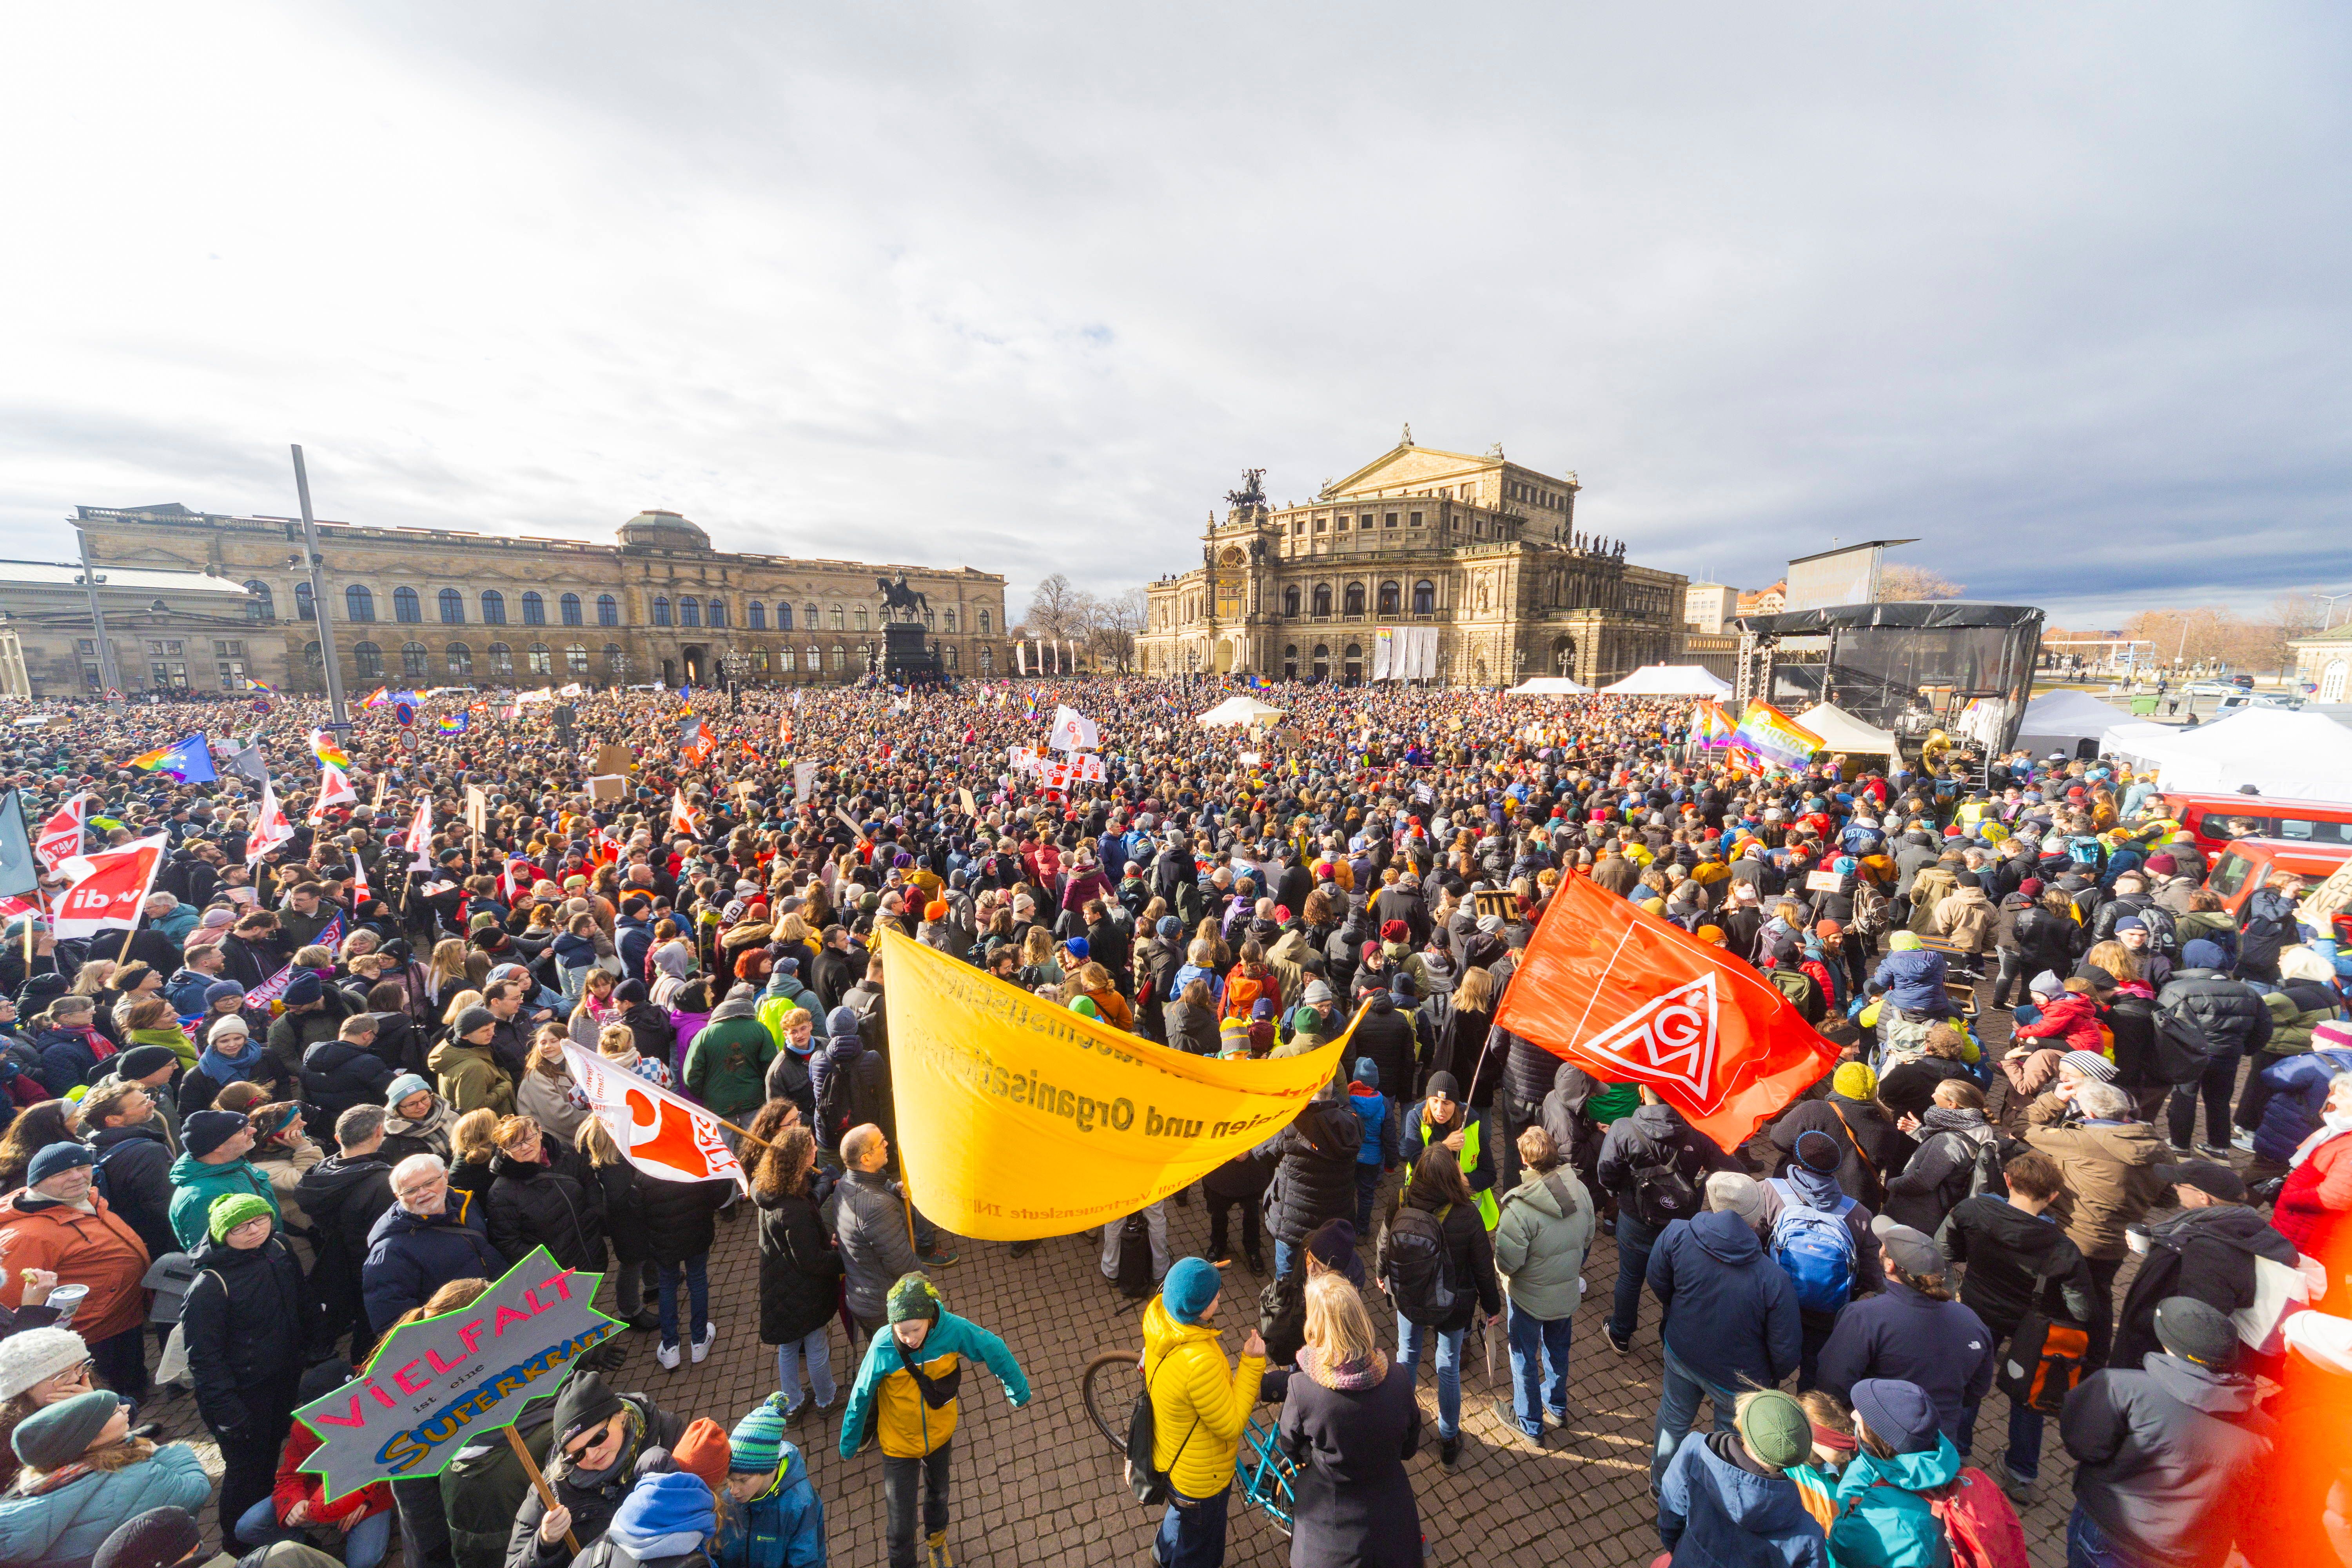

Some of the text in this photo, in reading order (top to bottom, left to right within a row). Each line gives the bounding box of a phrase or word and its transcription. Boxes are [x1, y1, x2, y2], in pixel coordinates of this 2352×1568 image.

[1047, 769, 1068, 778] GEW
[449, 1363, 485, 1390] eine
[413, 1395, 437, 1414] ist
